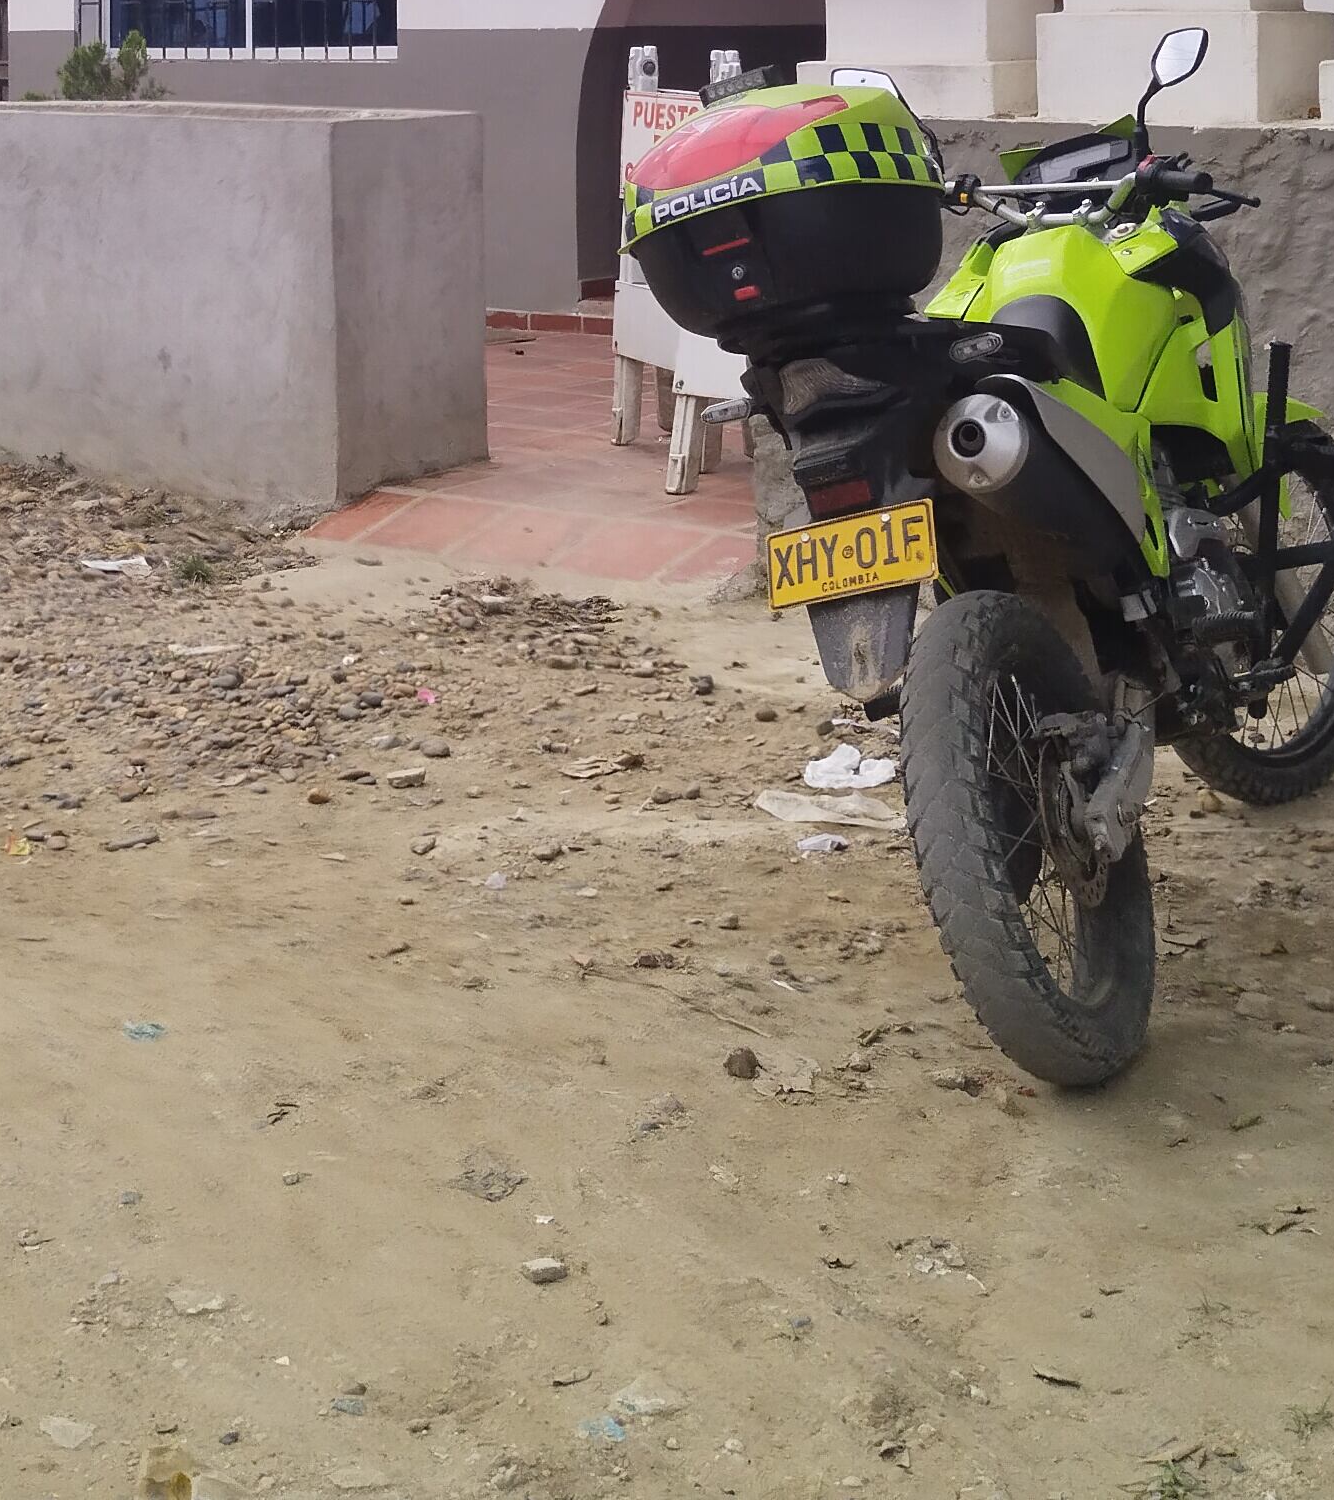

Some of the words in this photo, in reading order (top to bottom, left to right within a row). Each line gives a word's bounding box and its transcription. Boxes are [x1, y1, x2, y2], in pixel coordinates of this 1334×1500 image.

[654, 176, 763, 223] POLICÍA
[773, 533, 839, 590] XHY
[821, 571, 880, 593] COLOMBIA
